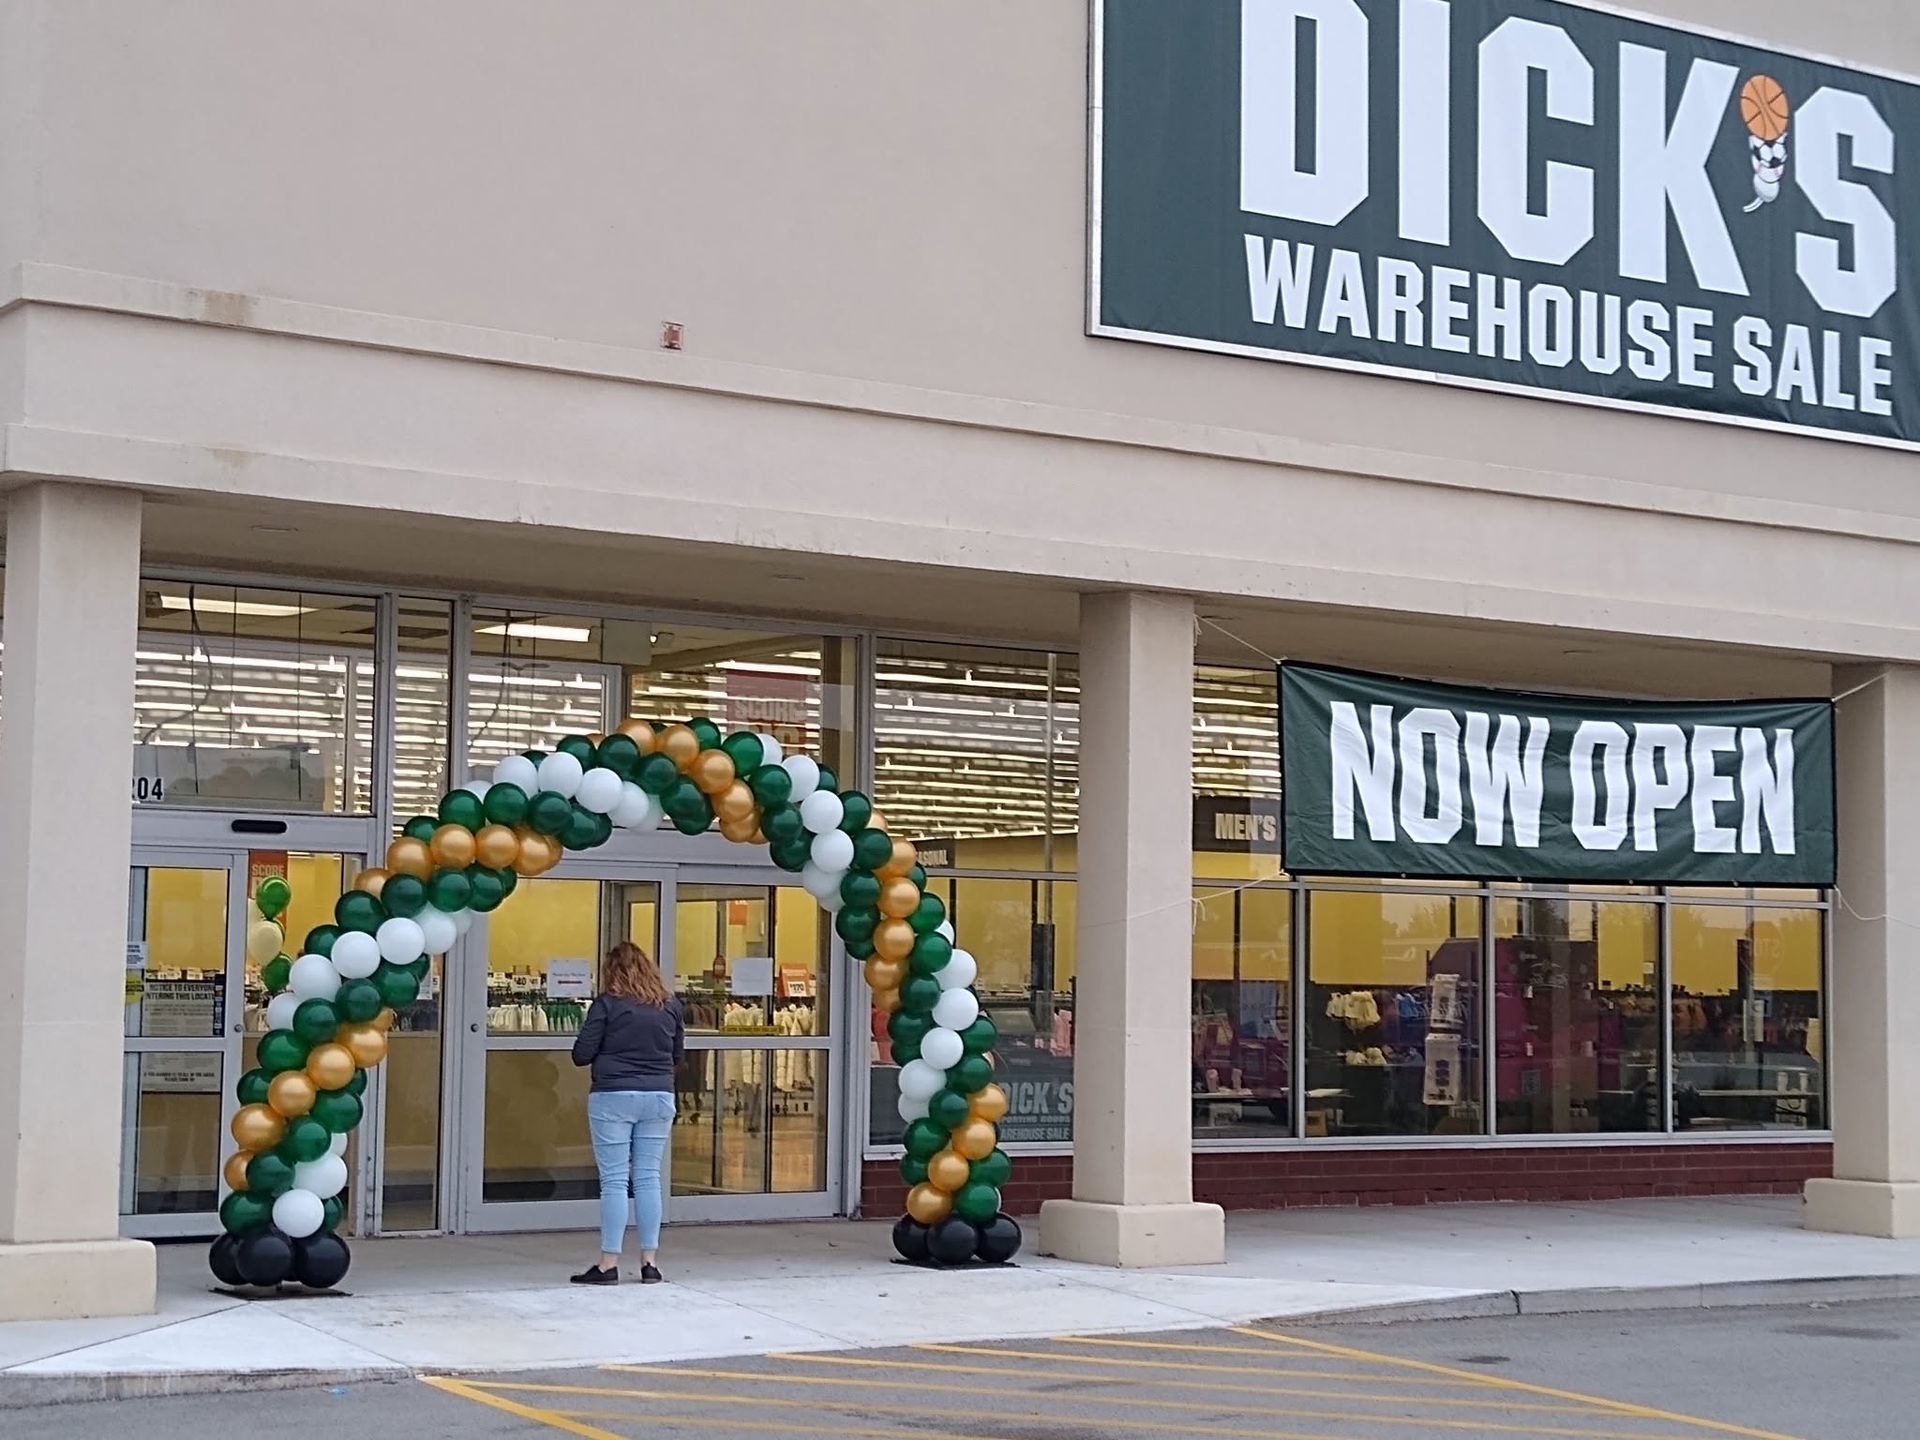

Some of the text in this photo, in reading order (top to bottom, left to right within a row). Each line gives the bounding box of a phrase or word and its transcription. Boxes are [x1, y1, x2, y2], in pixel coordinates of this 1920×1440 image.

[1240, 0, 1896, 318] DICK'S
[1243, 233, 1893, 417] WAREHOUSE SALE
[132, 777, 163, 800] 04
[1329, 700, 1797, 855] NOW OPEN
[1215, 812, 1277, 841] MEN'S
[251, 863, 285, 877] SCORE
[145, 992, 175, 1000] NTERING
[1000, 1127, 1045, 1140] AREHOUSE
